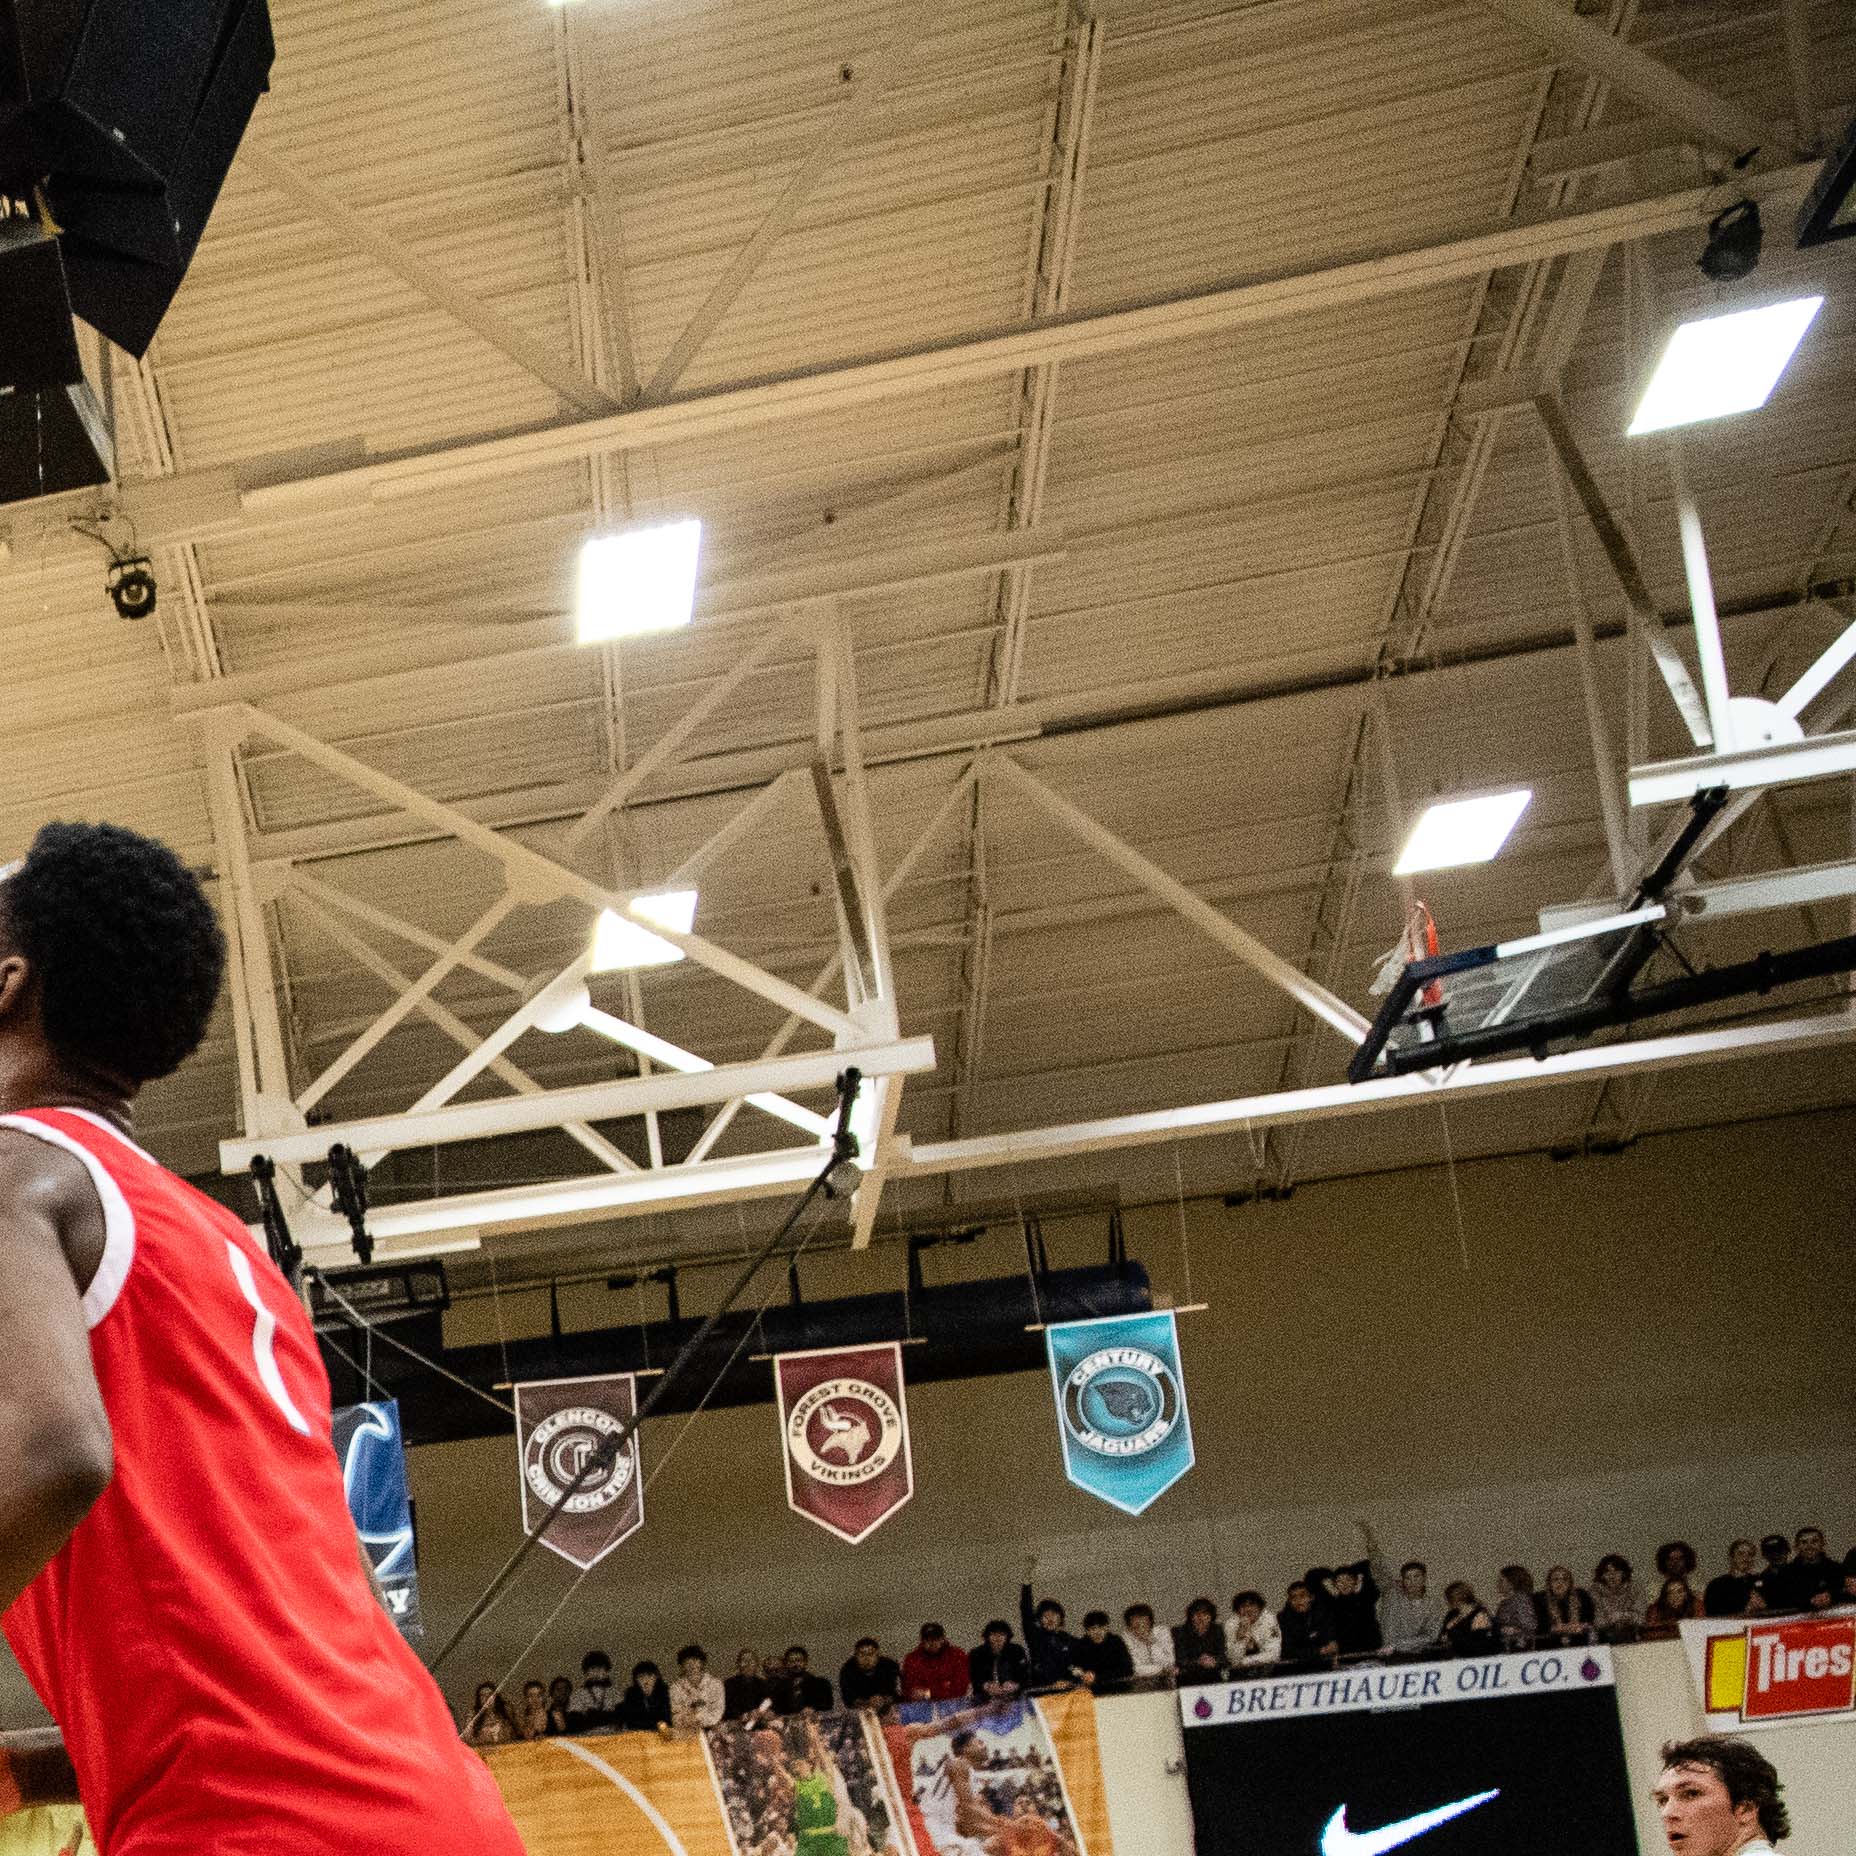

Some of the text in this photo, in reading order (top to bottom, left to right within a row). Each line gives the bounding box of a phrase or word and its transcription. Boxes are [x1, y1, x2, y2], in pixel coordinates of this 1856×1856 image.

[1072, 1349, 1165, 1386] CENTURY
[791, 1382, 899, 1438] FOREST GROVE
[1079, 1419, 1170, 1455] JAGUARS
[811, 1455, 886, 1481] VIKINGS
[1226, 1656, 1570, 1716] BRETTHAUER OIL CO.
[1752, 1633, 1853, 1694] Tires
